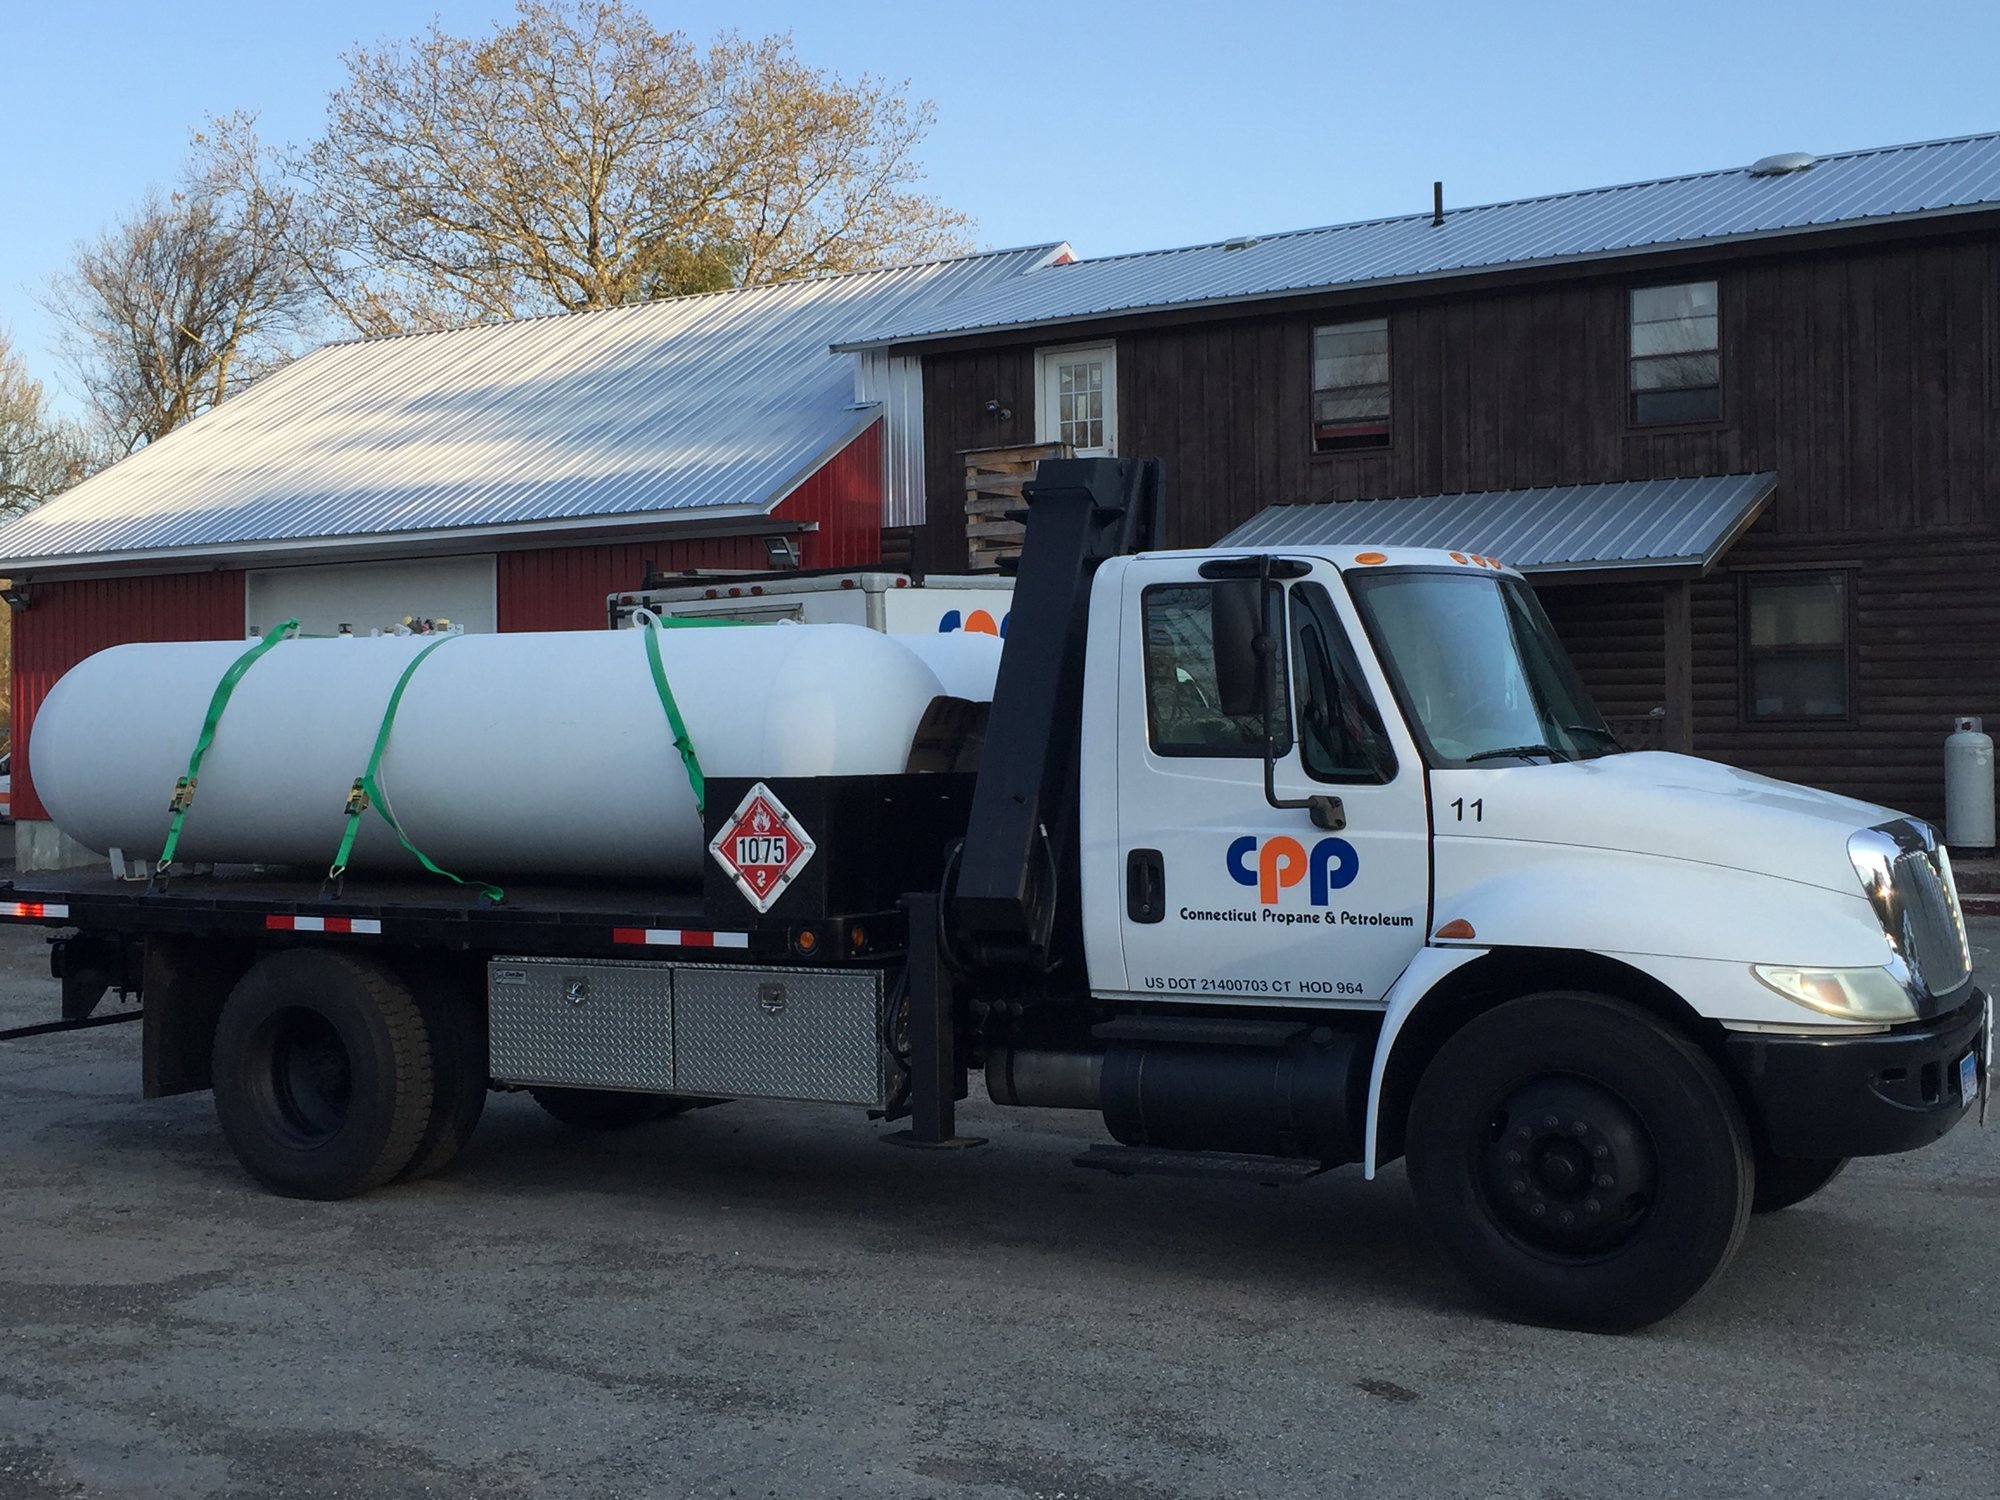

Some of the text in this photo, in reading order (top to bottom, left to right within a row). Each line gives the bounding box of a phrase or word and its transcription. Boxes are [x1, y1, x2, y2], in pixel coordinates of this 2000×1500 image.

[1450, 797, 1484, 822] 11
[739, 838, 785, 864] 1075
[756, 870, 767, 887] 2
[1180, 907, 1414, 926] Connecticut Propane & Petroleum
[1145, 976, 1364, 994] US DOT 21400703 CT HOD 964
